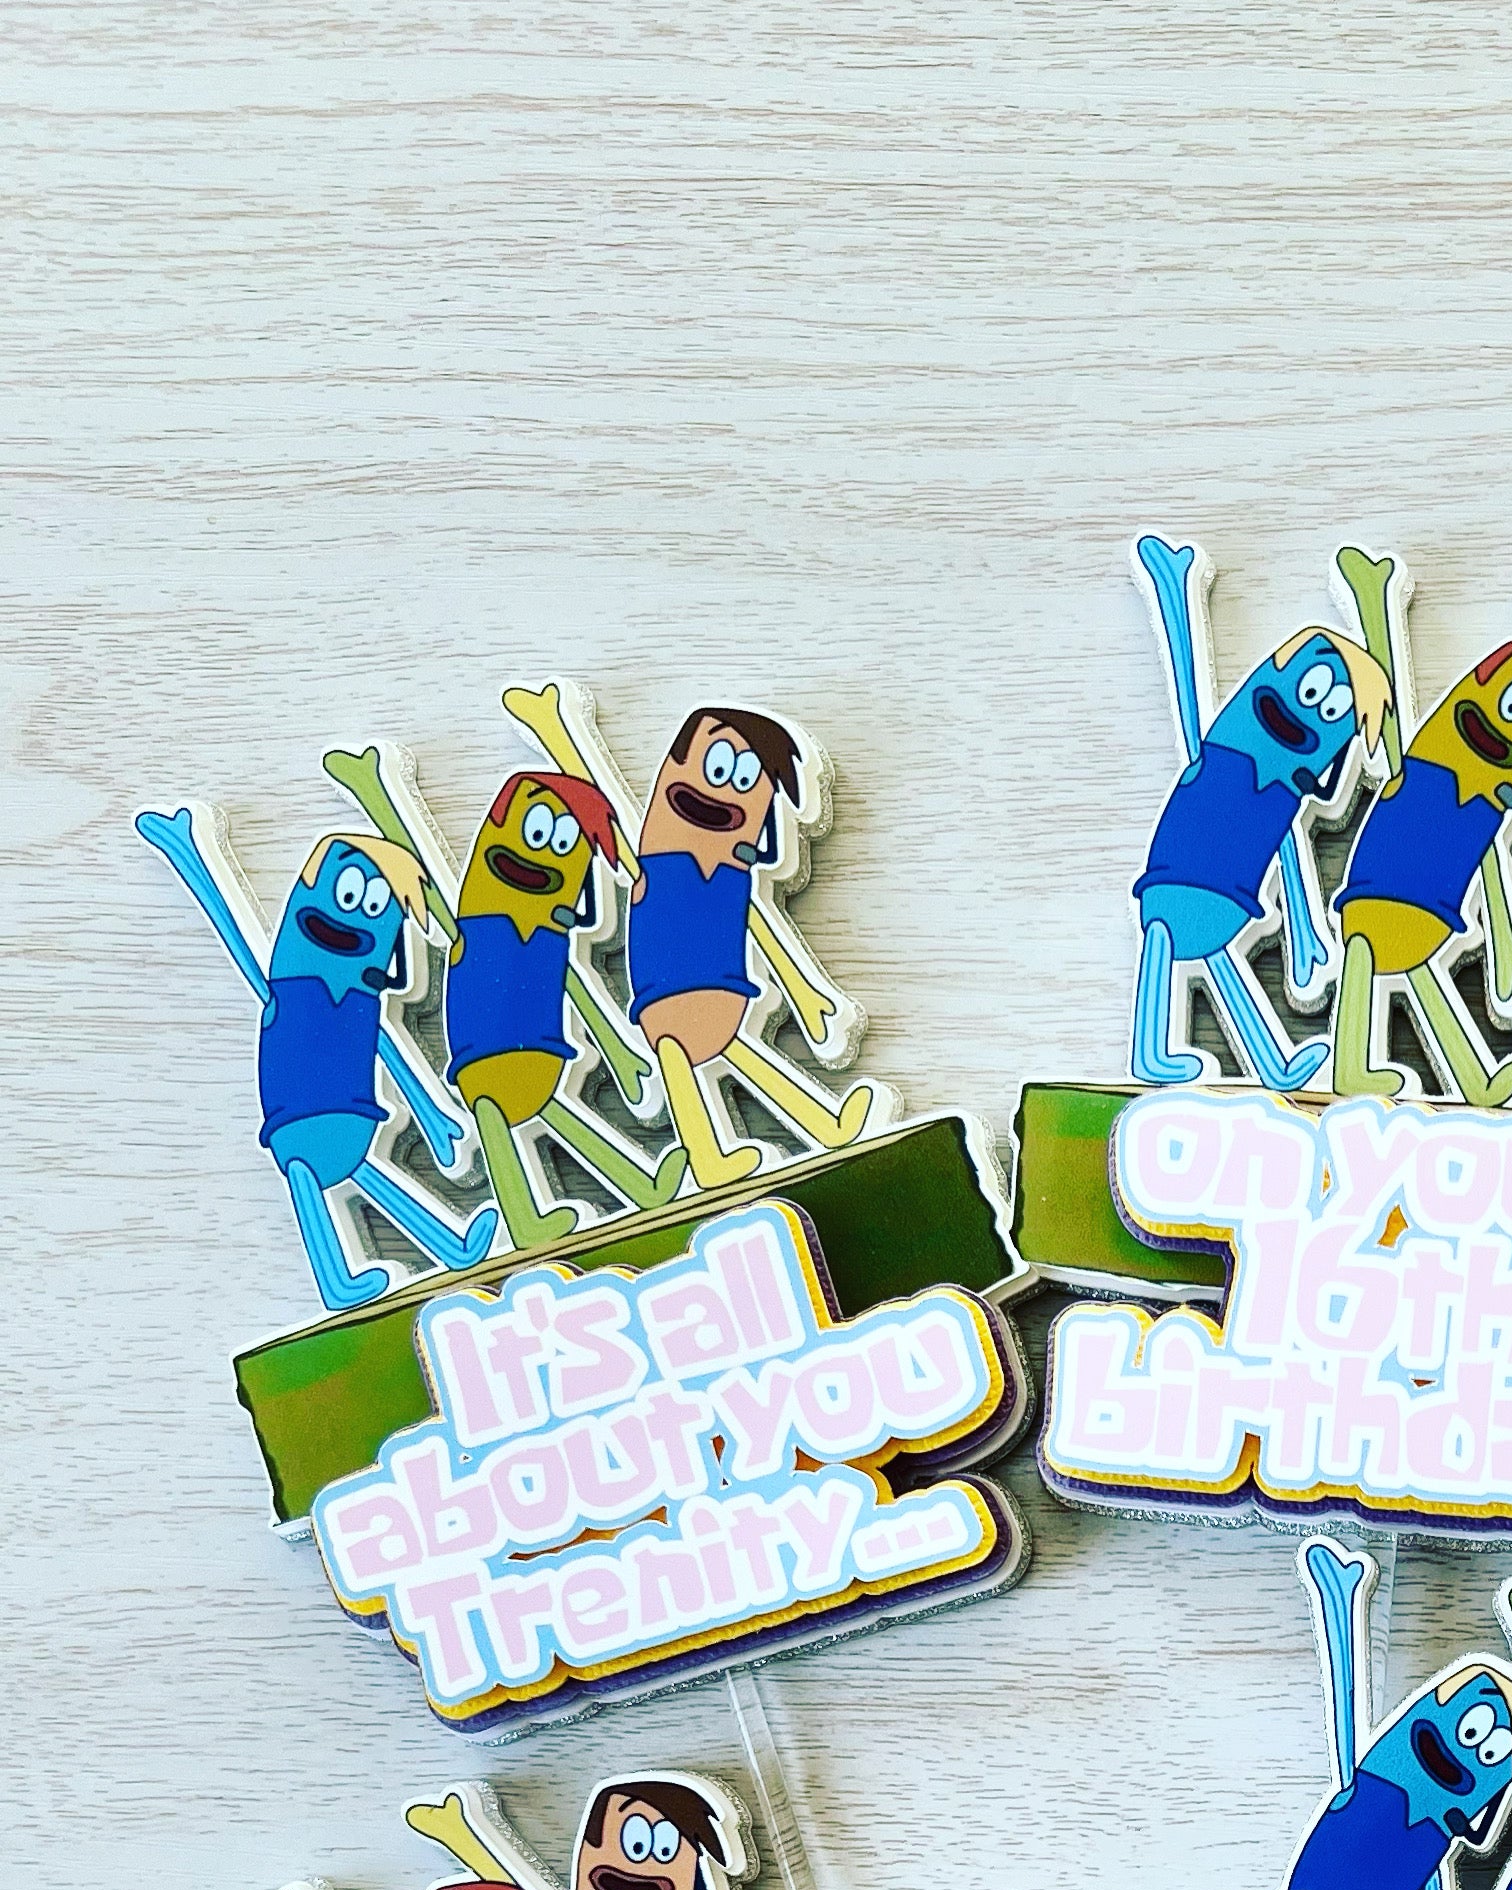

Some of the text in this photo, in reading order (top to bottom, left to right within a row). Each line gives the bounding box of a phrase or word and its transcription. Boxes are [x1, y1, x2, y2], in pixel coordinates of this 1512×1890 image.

[441, 1233, 795, 1437] It's all
[333, 1322, 968, 1582] about you
[407, 1489, 960, 1685] Trenity...
